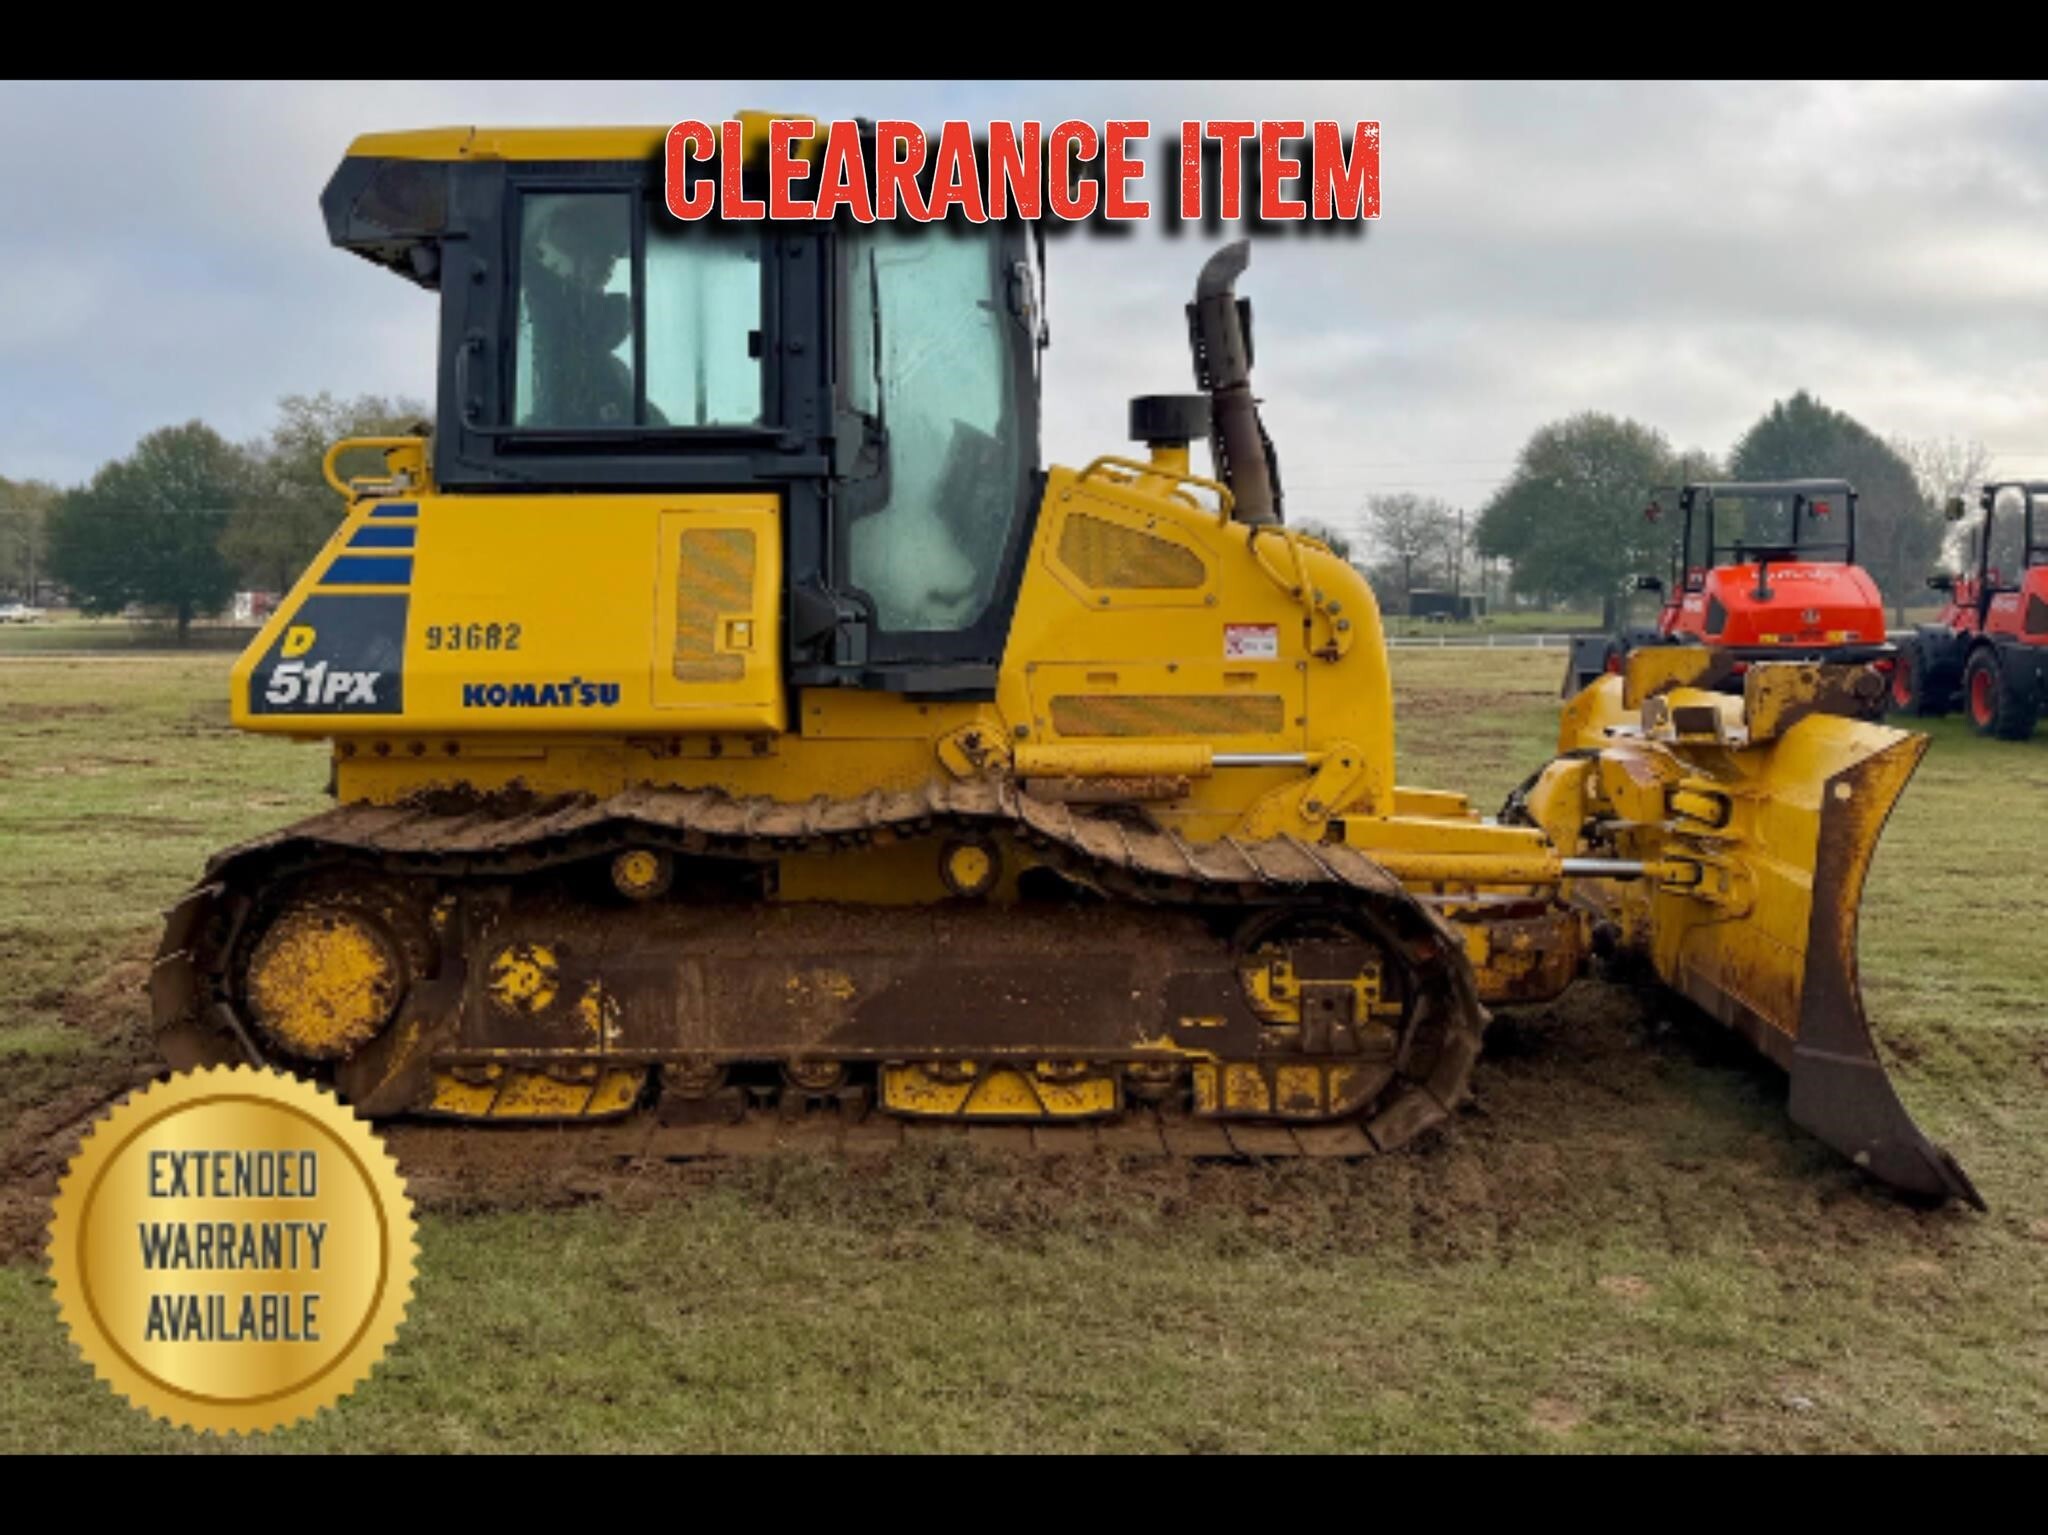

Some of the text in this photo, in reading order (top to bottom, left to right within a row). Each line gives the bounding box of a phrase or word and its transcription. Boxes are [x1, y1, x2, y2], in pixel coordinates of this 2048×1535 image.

[281, 625, 317, 658] D
[265, 660, 381, 704] 51PX
[462, 676, 621, 707] KOMATSU
